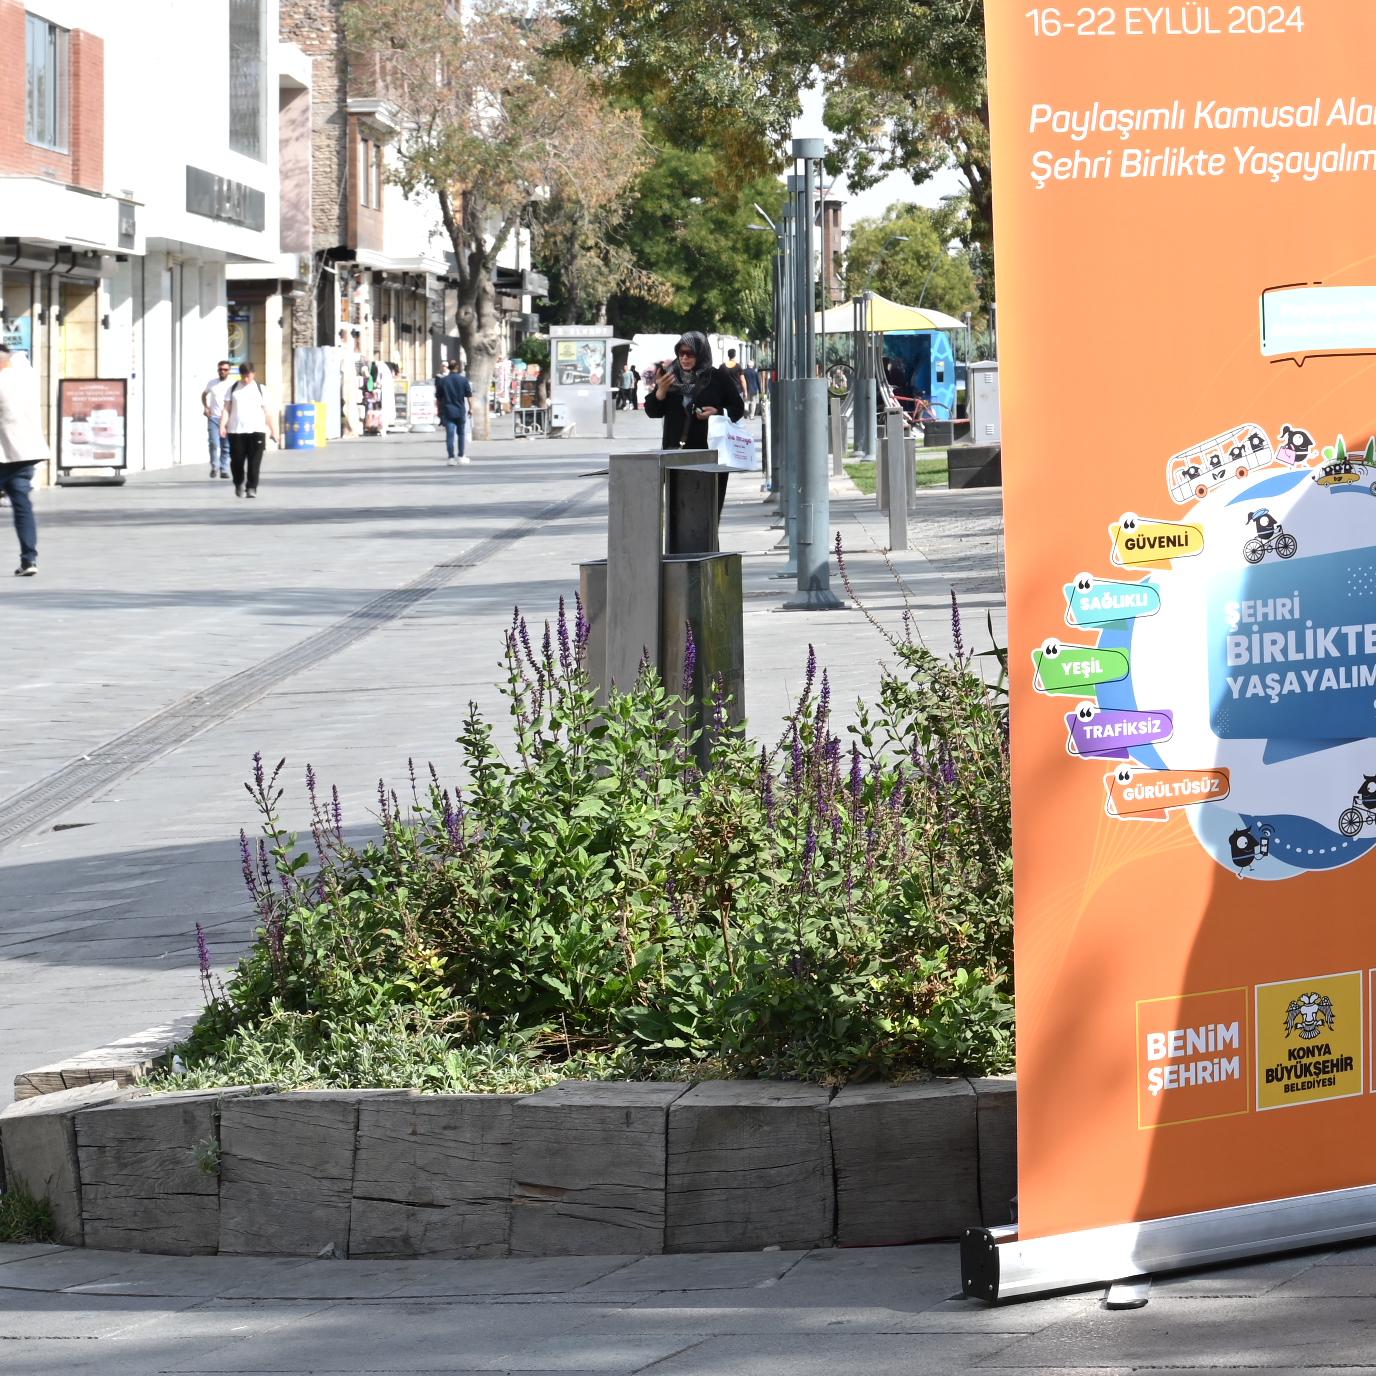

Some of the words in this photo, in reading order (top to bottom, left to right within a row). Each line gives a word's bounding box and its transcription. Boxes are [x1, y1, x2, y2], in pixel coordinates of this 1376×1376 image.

[1025, 7, 1116, 36] 16-22
[1125, 2, 1220, 35] EYLÜL
[1227, 5, 1304, 34] 2024
[1029, 102, 1185, 141] Paylaşımlı
[1194, 98, 1319, 129] Kamusal
[1030, 149, 1111, 189] Şehri
[1120, 147, 1225, 177] Birlikte
[1124, 530, 1189, 552] GÜVENLİ
[1079, 590, 1149, 612] SAĞLIKLI
[1225, 589, 1300, 633] ŞEHRİ
[1062, 656, 1103, 680] YEŞİL
[1083, 716, 1162, 740] TRAFİKSİZ
[1122, 776, 1220, 801] GÜRÜLTÜSÜZ
[1146, 1021, 1239, 1062] BENİM
[1287, 1043, 1332, 1062] KONYA
[1147, 1055, 1240, 1096] ŞEHRİM
[1265, 1054, 1354, 1085] BÜYÜKŞEHİR
[1284, 1073, 1336, 1094] BELEDİYESİ
